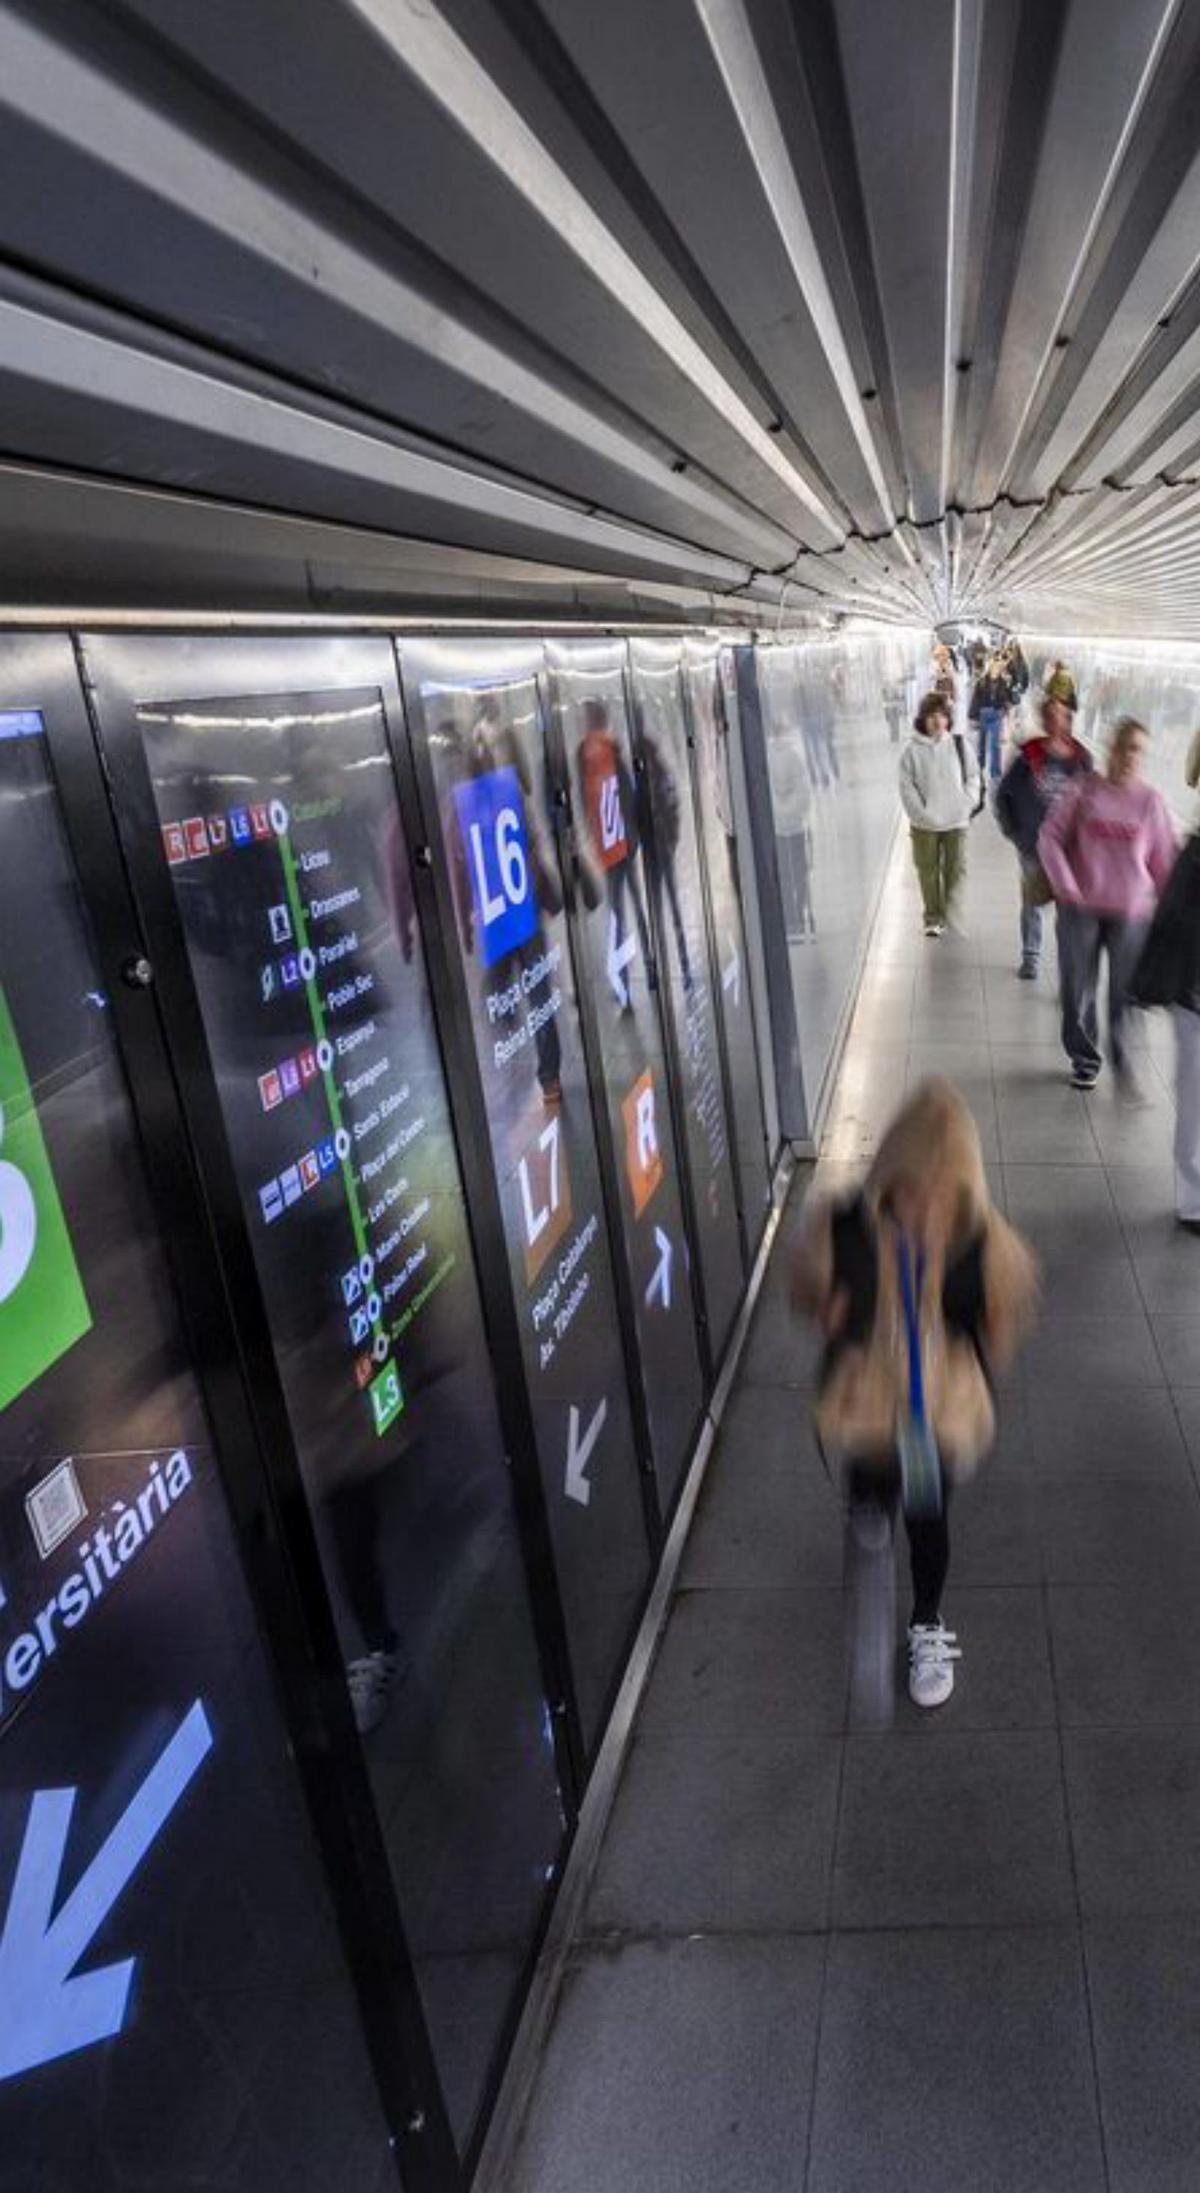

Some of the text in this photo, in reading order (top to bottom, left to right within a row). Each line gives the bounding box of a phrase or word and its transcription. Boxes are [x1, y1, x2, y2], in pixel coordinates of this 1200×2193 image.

[470, 808, 528, 926] L6
[487, 978, 522, 1024] Plaça
[637, 1089, 657, 1170] R
[518, 1116, 560, 1246] L7
[371, 1374, 398, 1422] L3
[0, 1450, 193, 1700] ersitària
